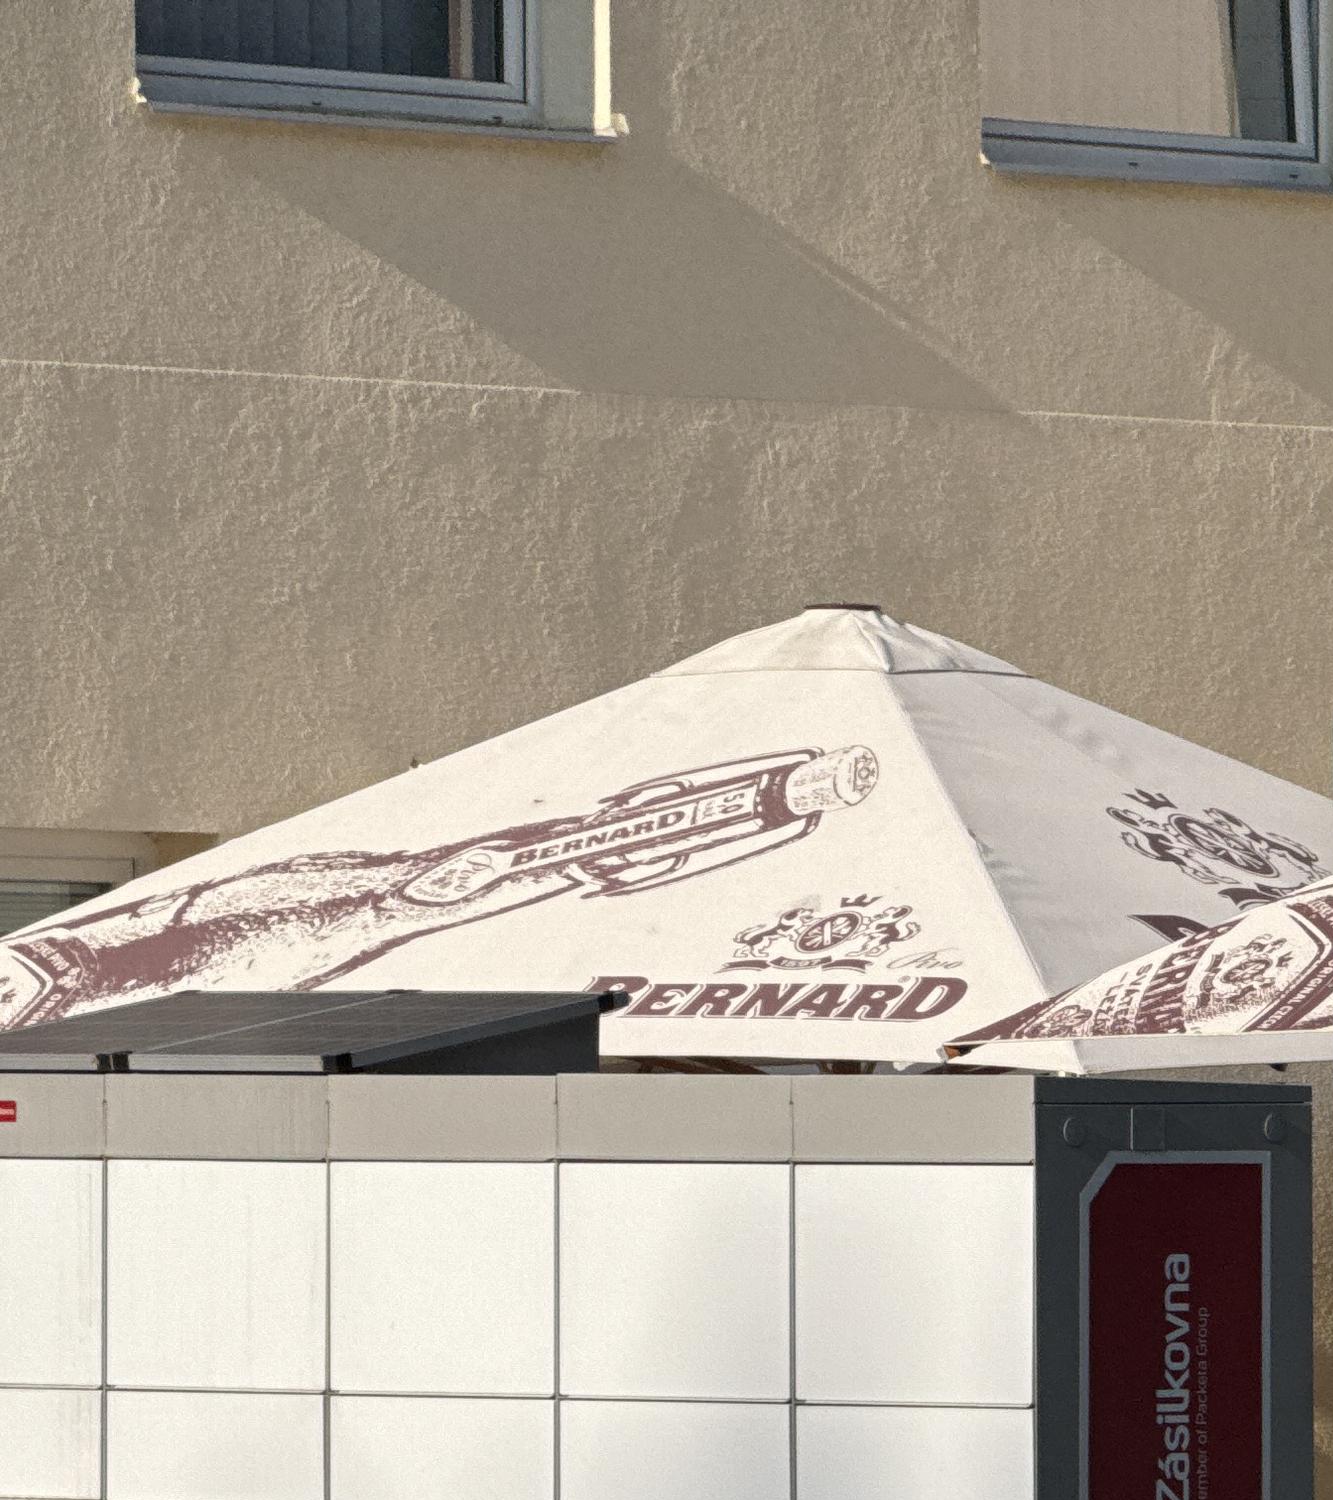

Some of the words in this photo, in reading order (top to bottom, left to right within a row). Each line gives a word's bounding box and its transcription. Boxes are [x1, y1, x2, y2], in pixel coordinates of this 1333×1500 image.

[510, 804, 686, 868] BERNARD
[1196, 1306, 1211, 1357] Group
[1196, 1429, 1208, 1444] of
